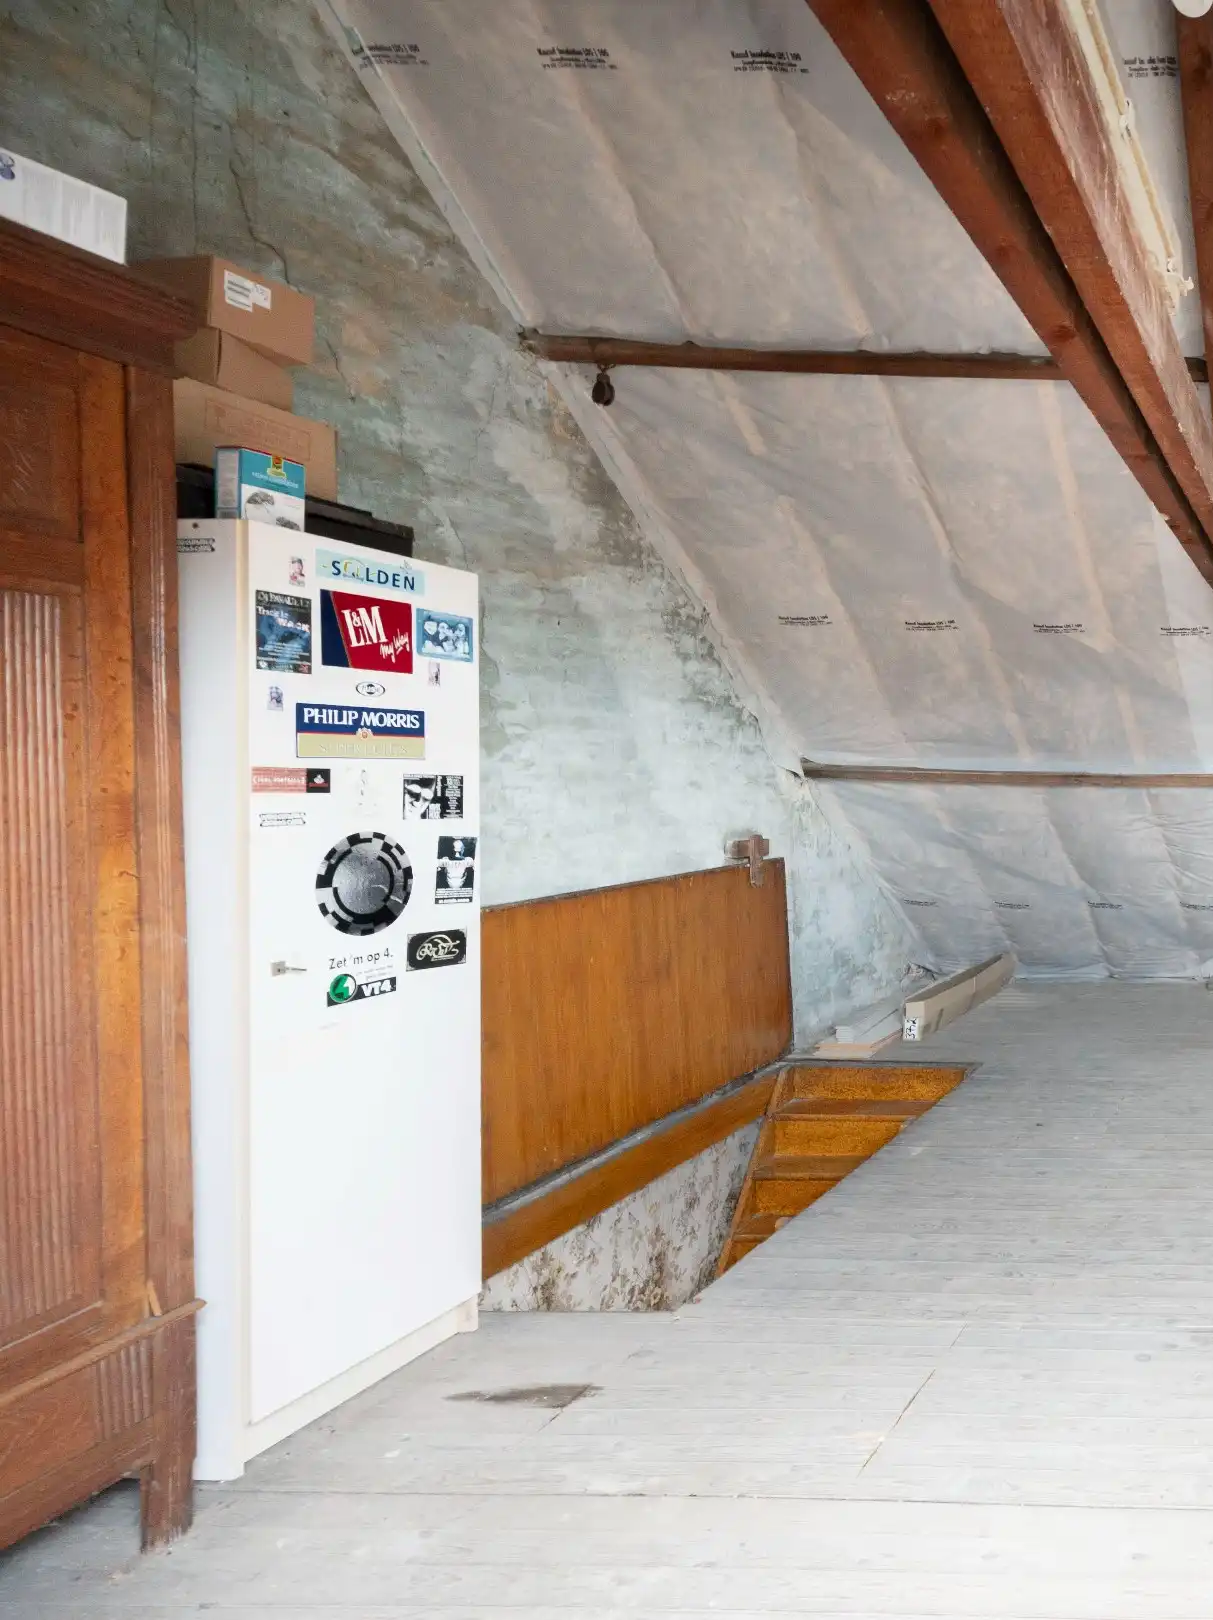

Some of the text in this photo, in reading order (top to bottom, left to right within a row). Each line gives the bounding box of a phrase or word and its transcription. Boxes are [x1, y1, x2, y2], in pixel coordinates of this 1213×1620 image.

[332, 560, 415, 591] SLDEN
[341, 605, 388, 647] L&M
[303, 707, 420, 729] PHILIP MORRIS
[329, 957, 347, 970] Zet
[367, 952, 380, 965] op
[361, 980, 392, 997] VT4
